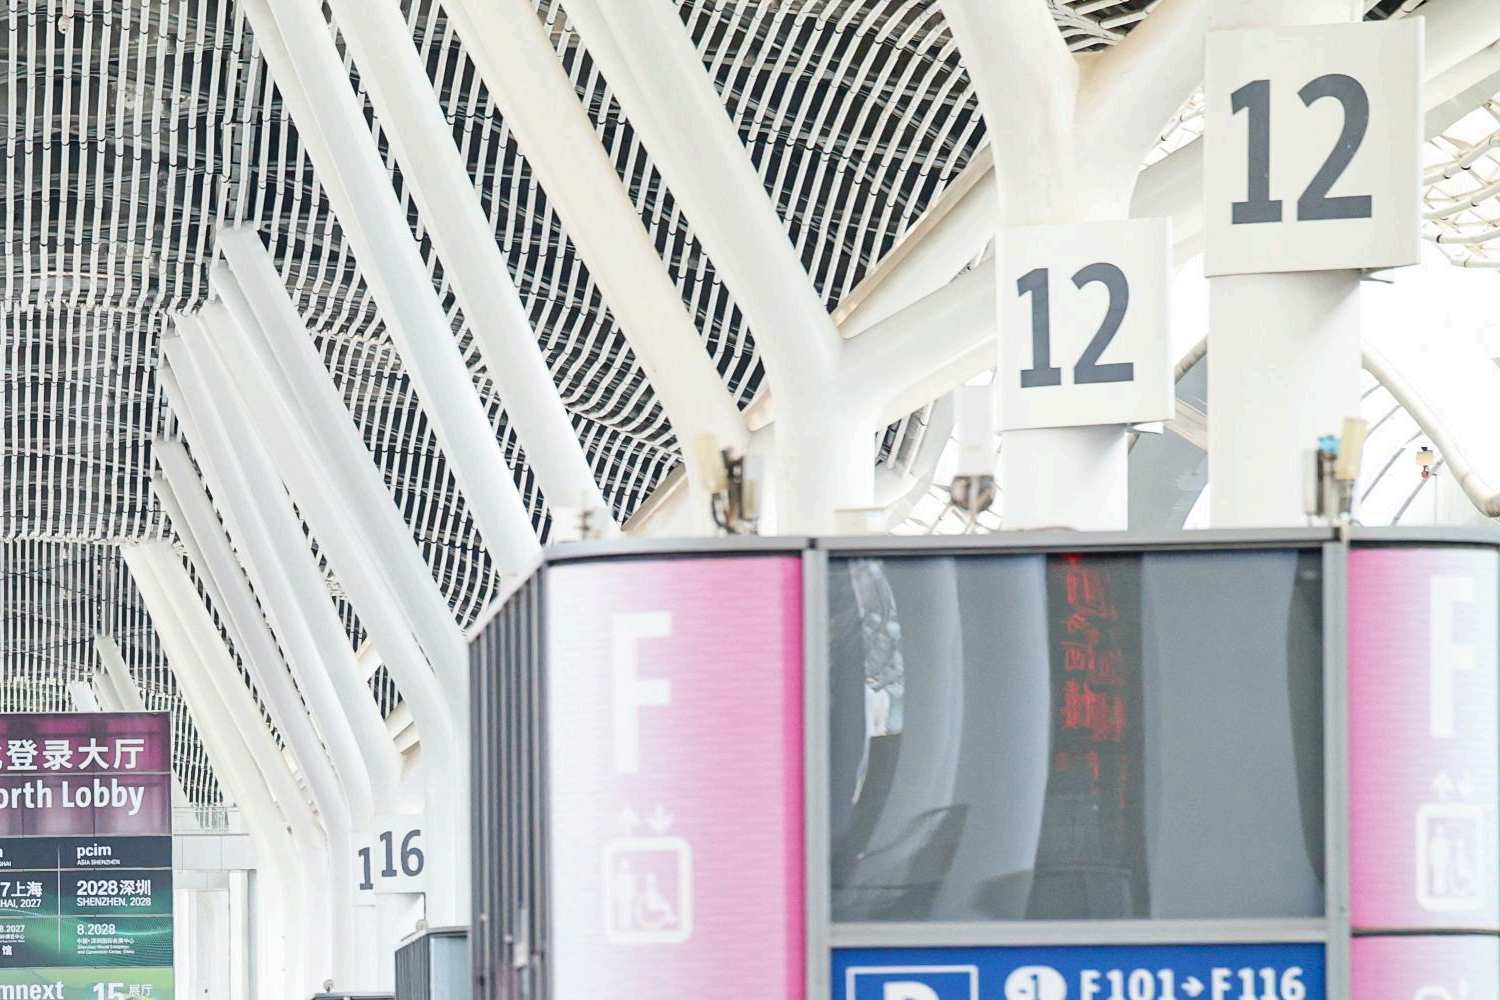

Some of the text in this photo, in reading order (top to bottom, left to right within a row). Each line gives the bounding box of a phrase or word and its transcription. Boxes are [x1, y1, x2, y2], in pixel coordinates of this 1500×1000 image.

[1230, 73, 1373, 225] 12
[1016, 262, 1134, 388] 12
[1430, 576, 1476, 737] F
[614, 609, 672, 774] F
[62, 778, 145, 816] Lobby
[77, 843, 112, 858] pcim
[358, 847, 373, 890] 1
[379, 829, 424, 877] 16
[20, 899, 42, 908] 2027
[77, 897, 152, 907] SHENZHEN, 2028
[77, 924, 116, 935] 8.2028
[129, 984, 153, 996] 展厅
